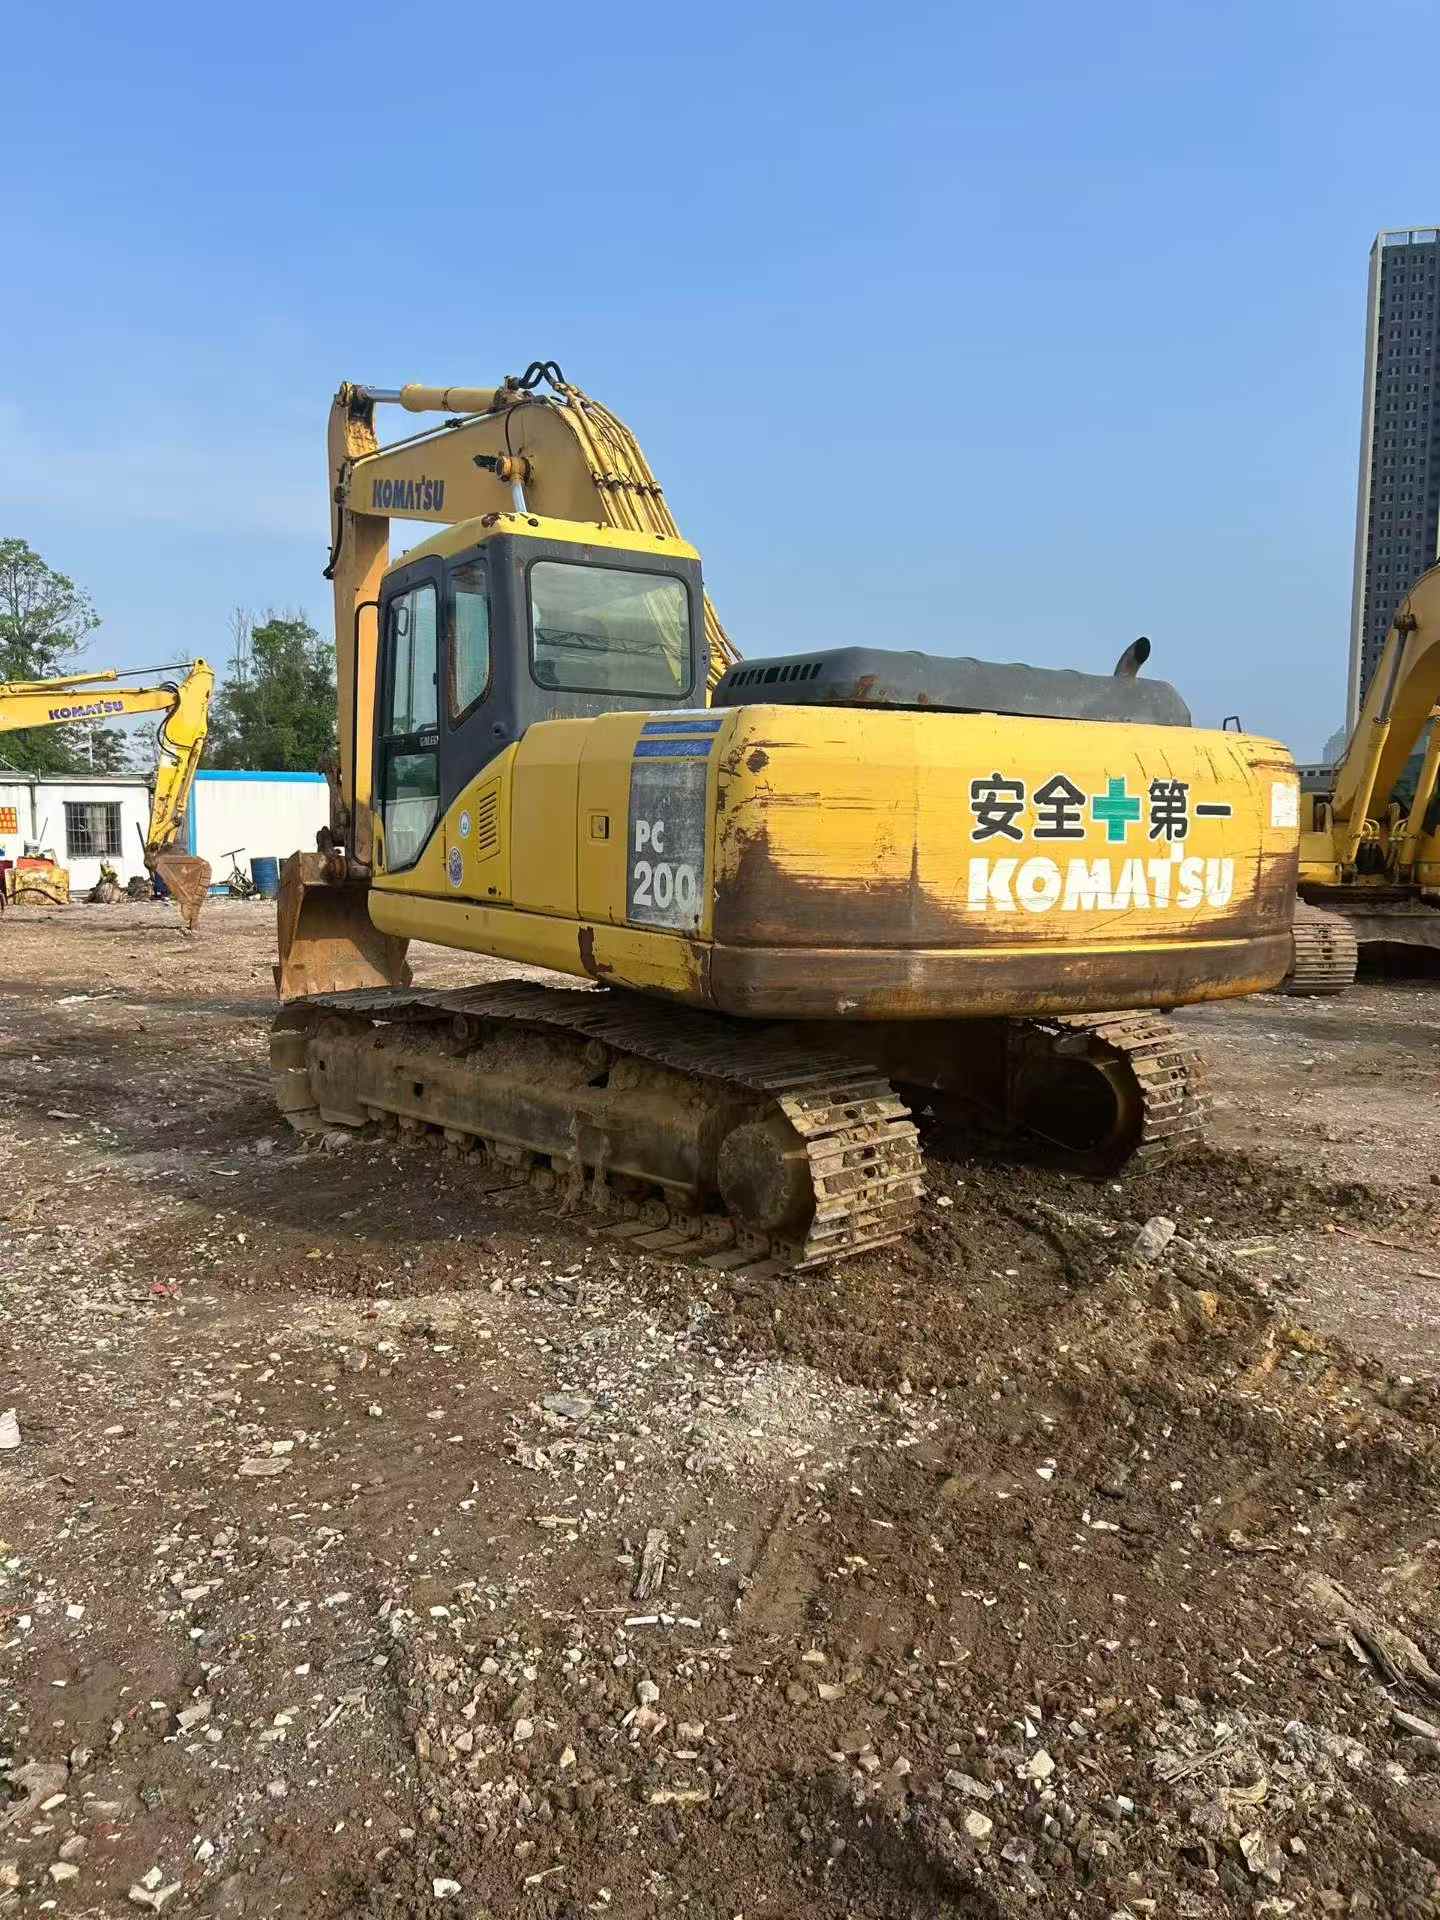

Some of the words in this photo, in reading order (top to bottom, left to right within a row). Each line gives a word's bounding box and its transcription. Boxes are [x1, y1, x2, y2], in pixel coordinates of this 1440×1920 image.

[372, 475, 445, 512] KOMATSU
[48, 700, 123, 720] KOMATSU
[635, 818, 665, 853] PC
[633, 860, 697, 912] 200
[967, 842, 1235, 913] KOMATSU
